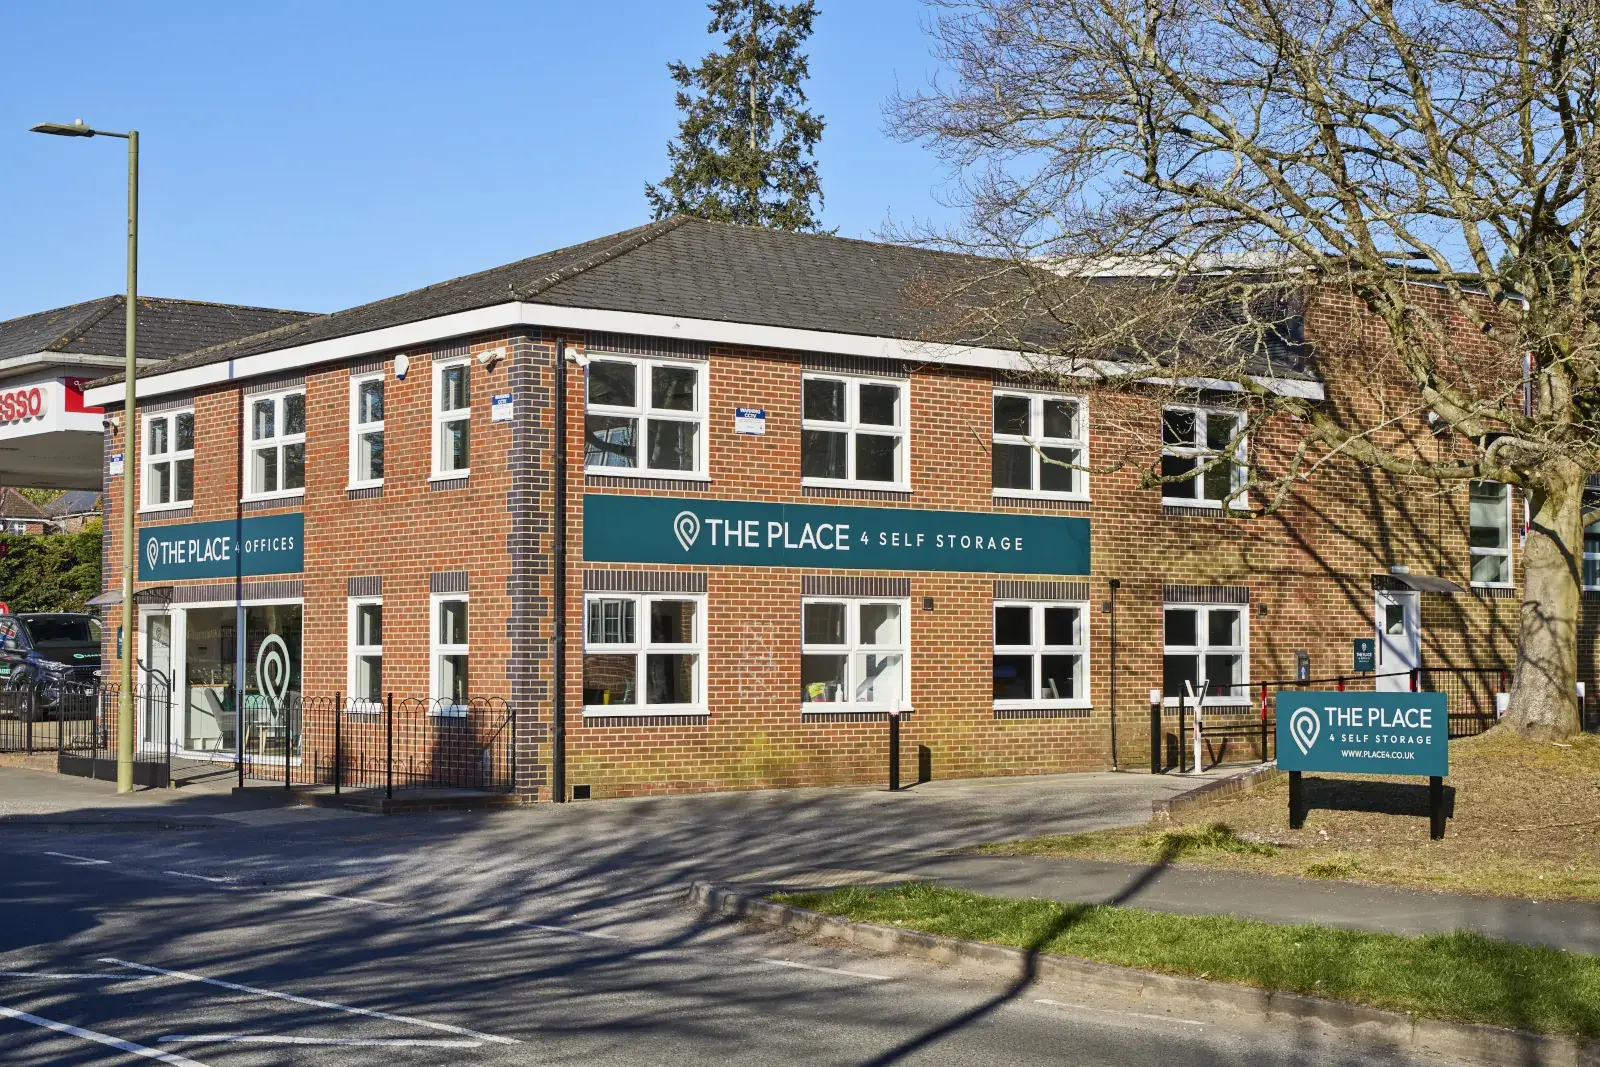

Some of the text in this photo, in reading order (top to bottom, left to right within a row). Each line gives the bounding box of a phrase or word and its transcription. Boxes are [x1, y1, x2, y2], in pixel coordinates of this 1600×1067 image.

[0, 388, 41, 421] SSO
[740, 407, 761, 415] WARNING
[705, 518, 1023, 551] THE PLACE 4 SELF STORAGE
[160, 536, 294, 565] THE PLACE 4 OFFICES
[1324, 707, 1432, 728] THE PLACE
[1329, 734, 1432, 744] 4 SELF STORAGE
[1341, 749, 1415, 760] WWW.PLACE4.CO.UK
